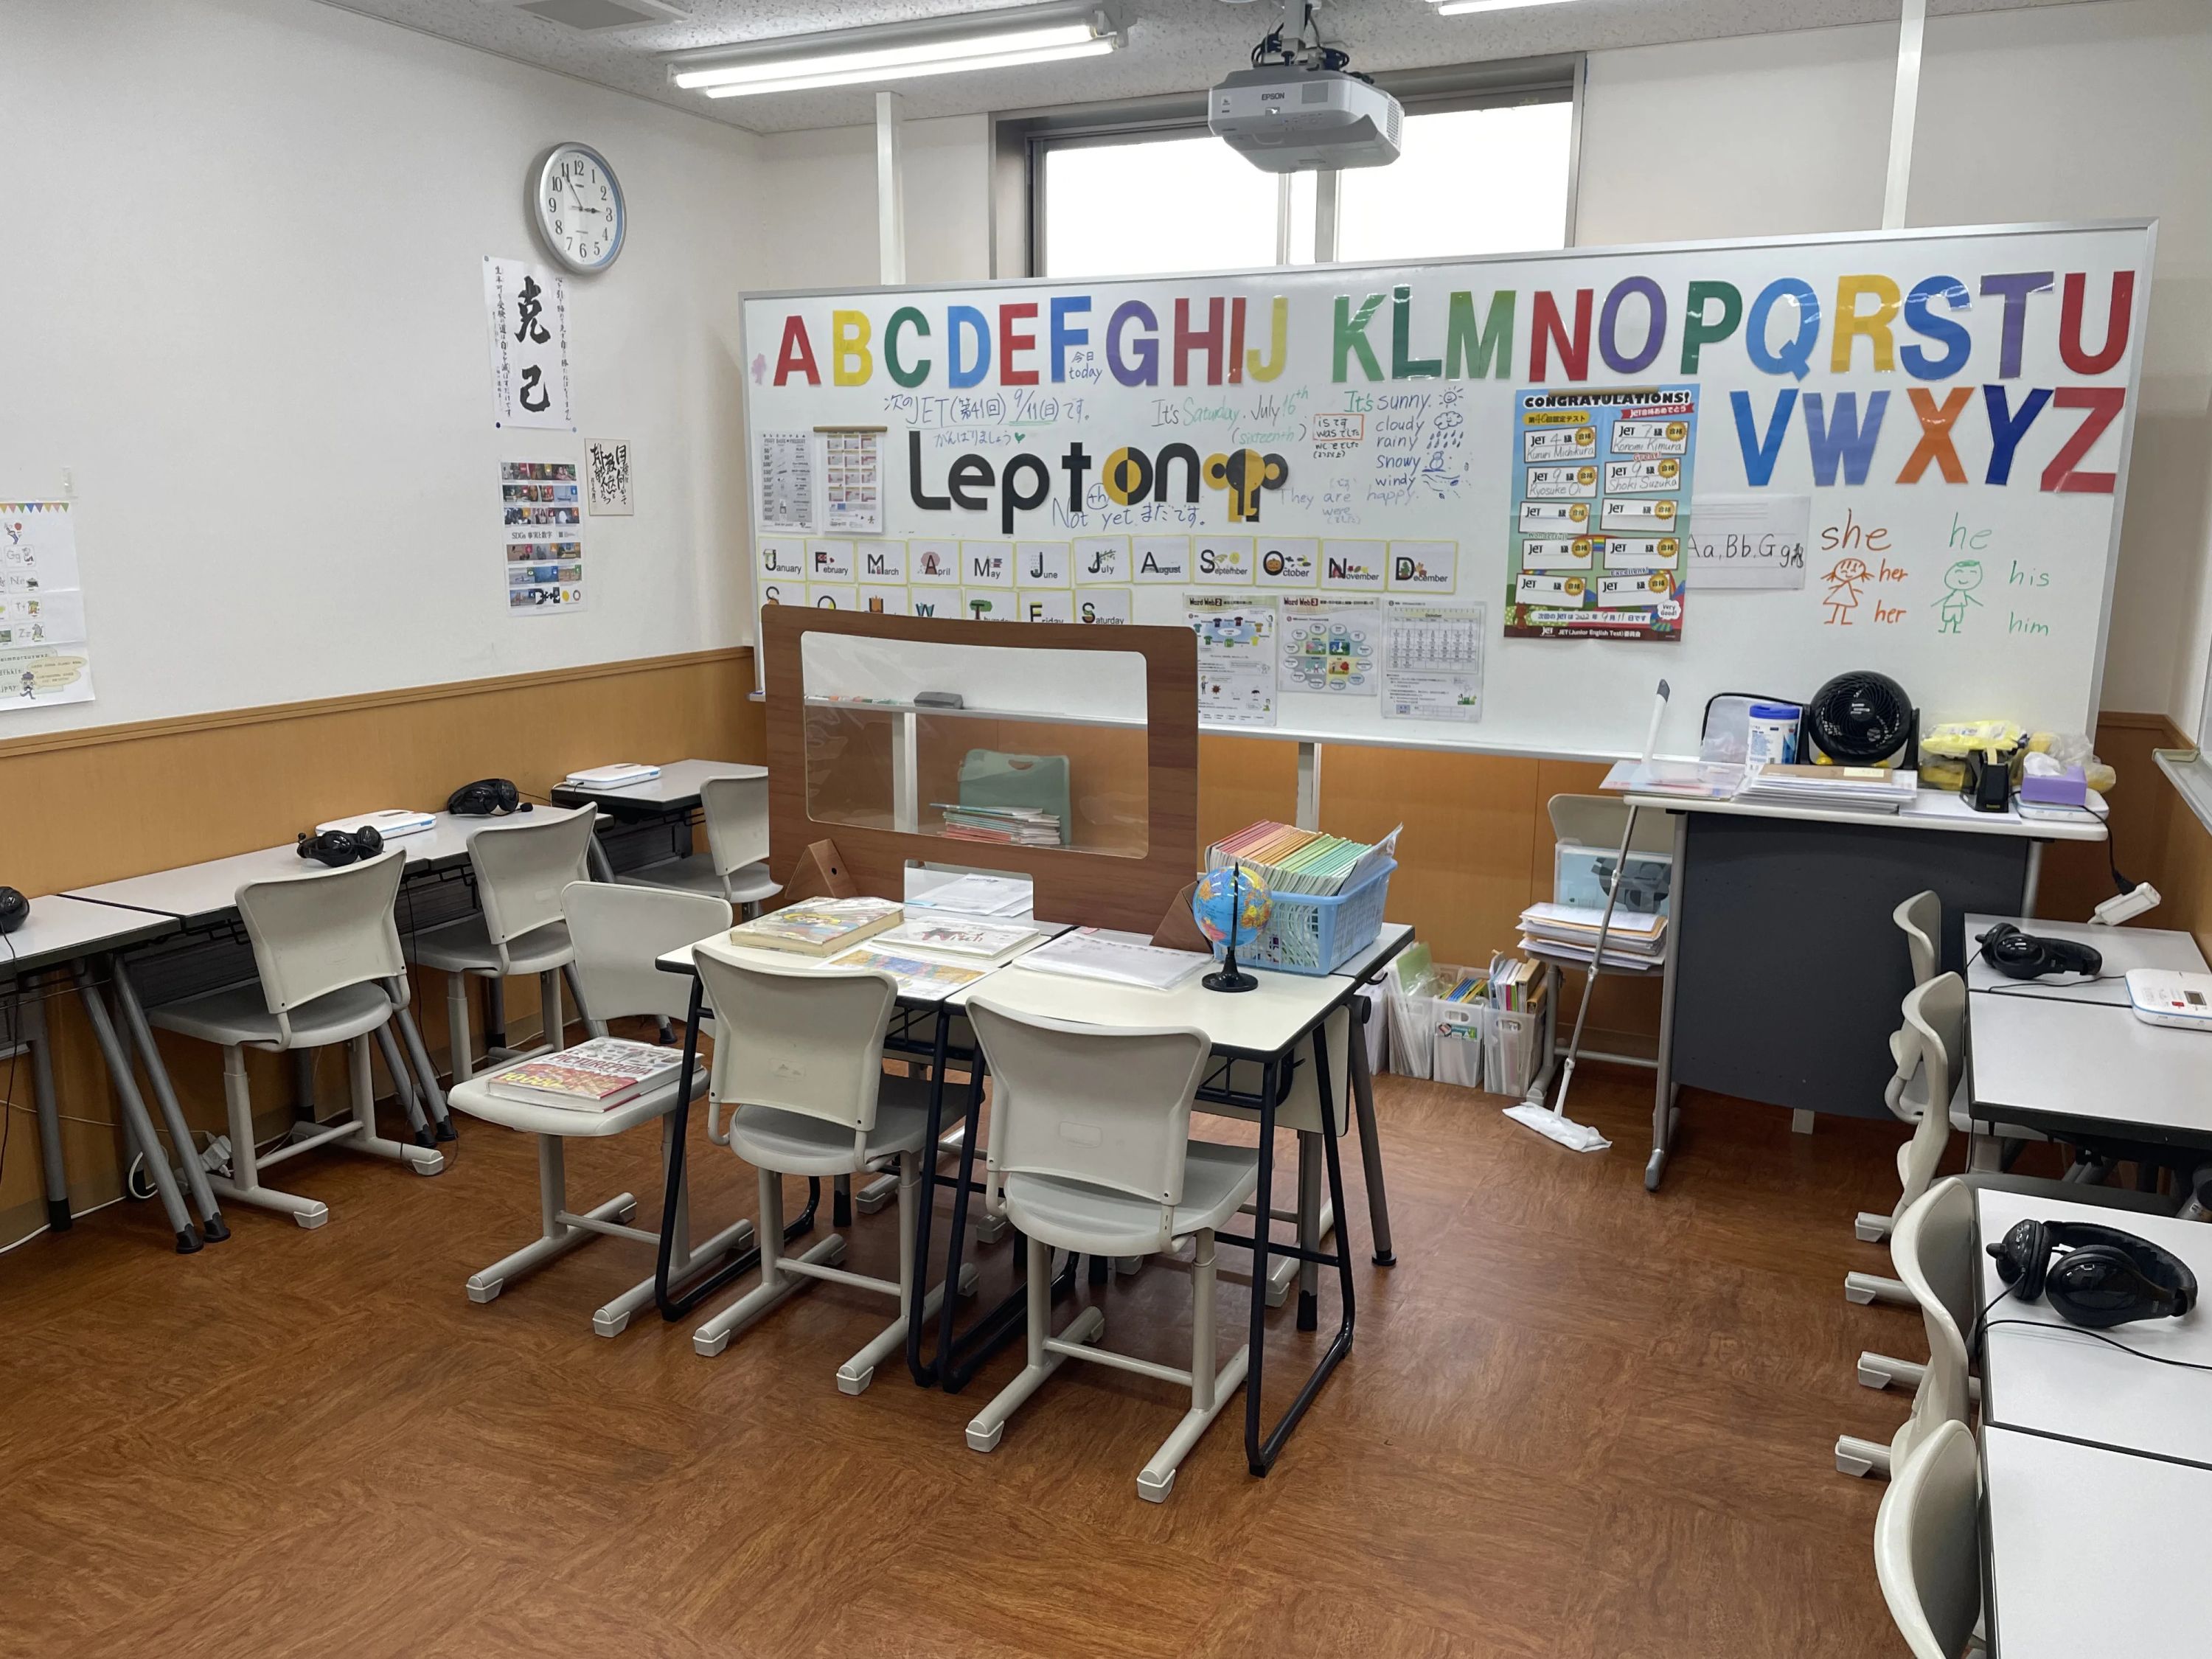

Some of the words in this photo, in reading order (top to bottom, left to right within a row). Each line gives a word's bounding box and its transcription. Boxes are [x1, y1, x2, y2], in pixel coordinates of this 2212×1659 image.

[1262, 92, 1285, 100] EPSON
[561, 162, 569, 180] 11
[574, 160, 584, 175] 12
[591, 169, 596, 184] 1
[552, 176, 562, 192] 10
[600, 186, 607, 201] 2
[549, 198, 557, 213] 9
[606, 207, 613, 222] 3
[555, 220, 563, 234] 8
[602, 227, 608, 241] 4
[566, 237, 573, 251] 7
[580, 243, 587, 258] 6
[594, 242, 600, 255] 5
[1071, 351, 1094, 363] 今日
[1068, 364, 1103, 384] today
[1344, 391, 1374, 413] It's
[1525, 392, 1689, 407] CONGRATULATIONS!
[1151, 399, 1179, 426] It's
[1251, 394, 1280, 426] July
[1318, 417, 1330, 427] is
[1376, 416, 1425, 437] cloudy
[1642, 424, 1652, 438] 7
[935, 431, 1012, 448] がんばりましょう
[1316, 429, 1337, 437] was
[1377, 436, 1418, 451] rainy
[1550, 434, 1561, 451] 4
[1647, 438, 1682, 451] Kimura
[1377, 454, 1421, 476] snowy
[1632, 462, 1641, 477] 9
[908, 431, 1200, 534] Lepton
[1375, 475, 1416, 490] windy
[1552, 468, 1562, 483] 9
[1639, 477, 1677, 490] Suzuka
[1281, 488, 1314, 509] They
[1324, 493, 1352, 503] are
[1052, 497, 1088, 529] Not
[1322, 507, 1352, 516] were
[1821, 508, 1891, 551] she
[1950, 512, 1992, 549] he
[764, 549, 801, 574] January
[815, 552, 848, 574] February
[868, 554, 899, 576] March
[925, 554, 950, 577] April
[974, 558, 1001, 579] May
[1031, 552, 1057, 579] June
[1088, 552, 1114, 574] July
[1141, 552, 1181, 575] August
[1200, 549, 1248, 577] September
[1263, 551, 1310, 577] October
[1329, 557, 1379, 581] November
[1395, 557, 1448, 583] December
[1879, 558, 1908, 582] her
[2009, 560, 2049, 587] his
[1874, 599, 1907, 622] her
[2009, 611, 2049, 636] him
